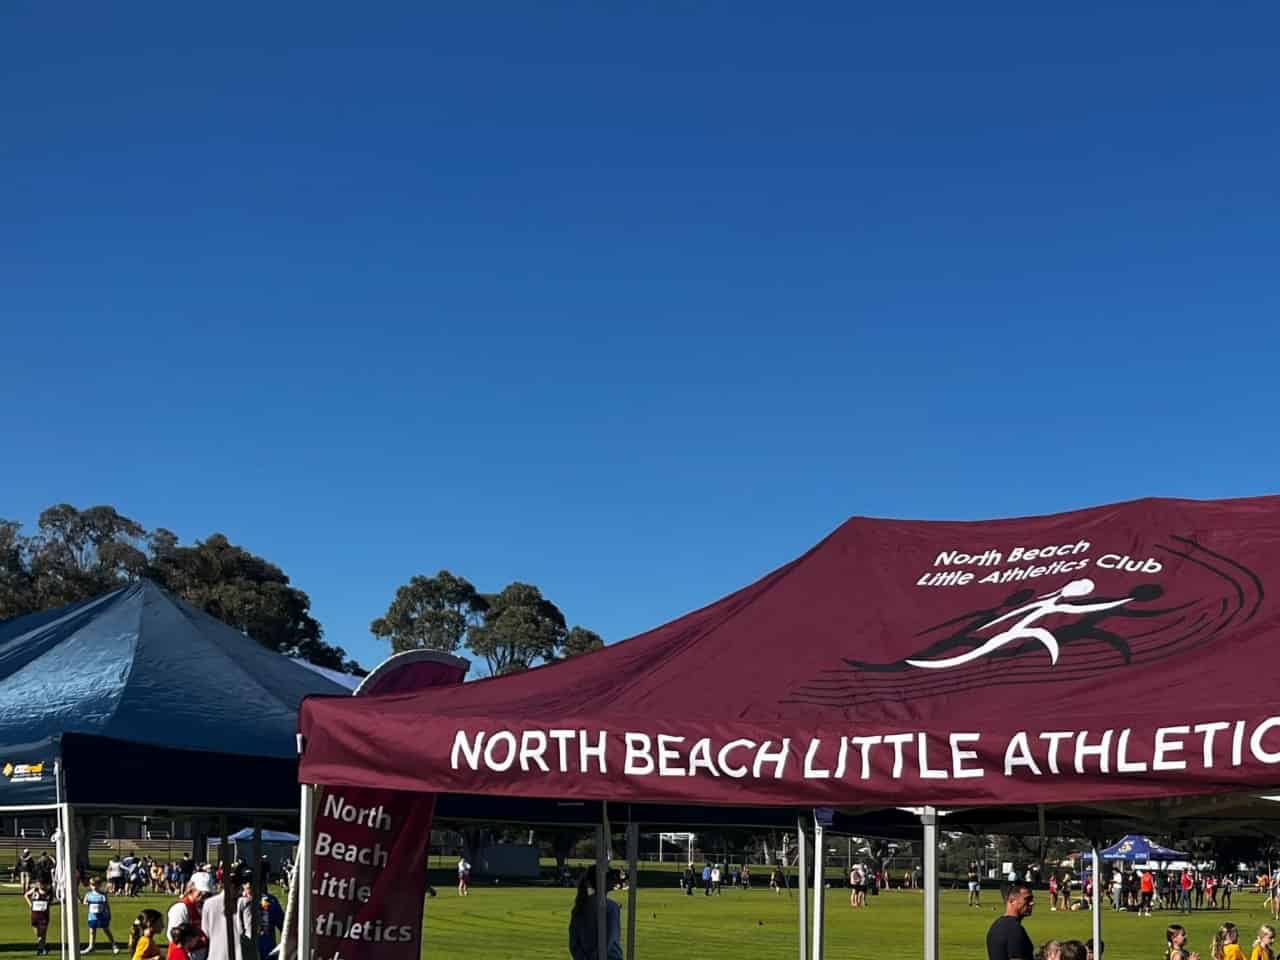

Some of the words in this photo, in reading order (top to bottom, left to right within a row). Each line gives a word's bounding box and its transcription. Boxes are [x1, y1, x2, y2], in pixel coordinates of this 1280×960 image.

[916, 572, 976, 587] Little
[978, 558, 1090, 584] Athletics
[1095, 553, 1163, 574] Club
[934, 550, 1002, 567] North
[1007, 539, 1091, 563] Beach
[450, 729, 608, 774] NORTH
[623, 731, 790, 779] BEACH
[802, 731, 985, 780] LITTLE
[323, 794, 393, 831] North
[314, 832, 389, 870] Beach
[311, 871, 372, 903] ittle
[315, 911, 413, 943] thletics
